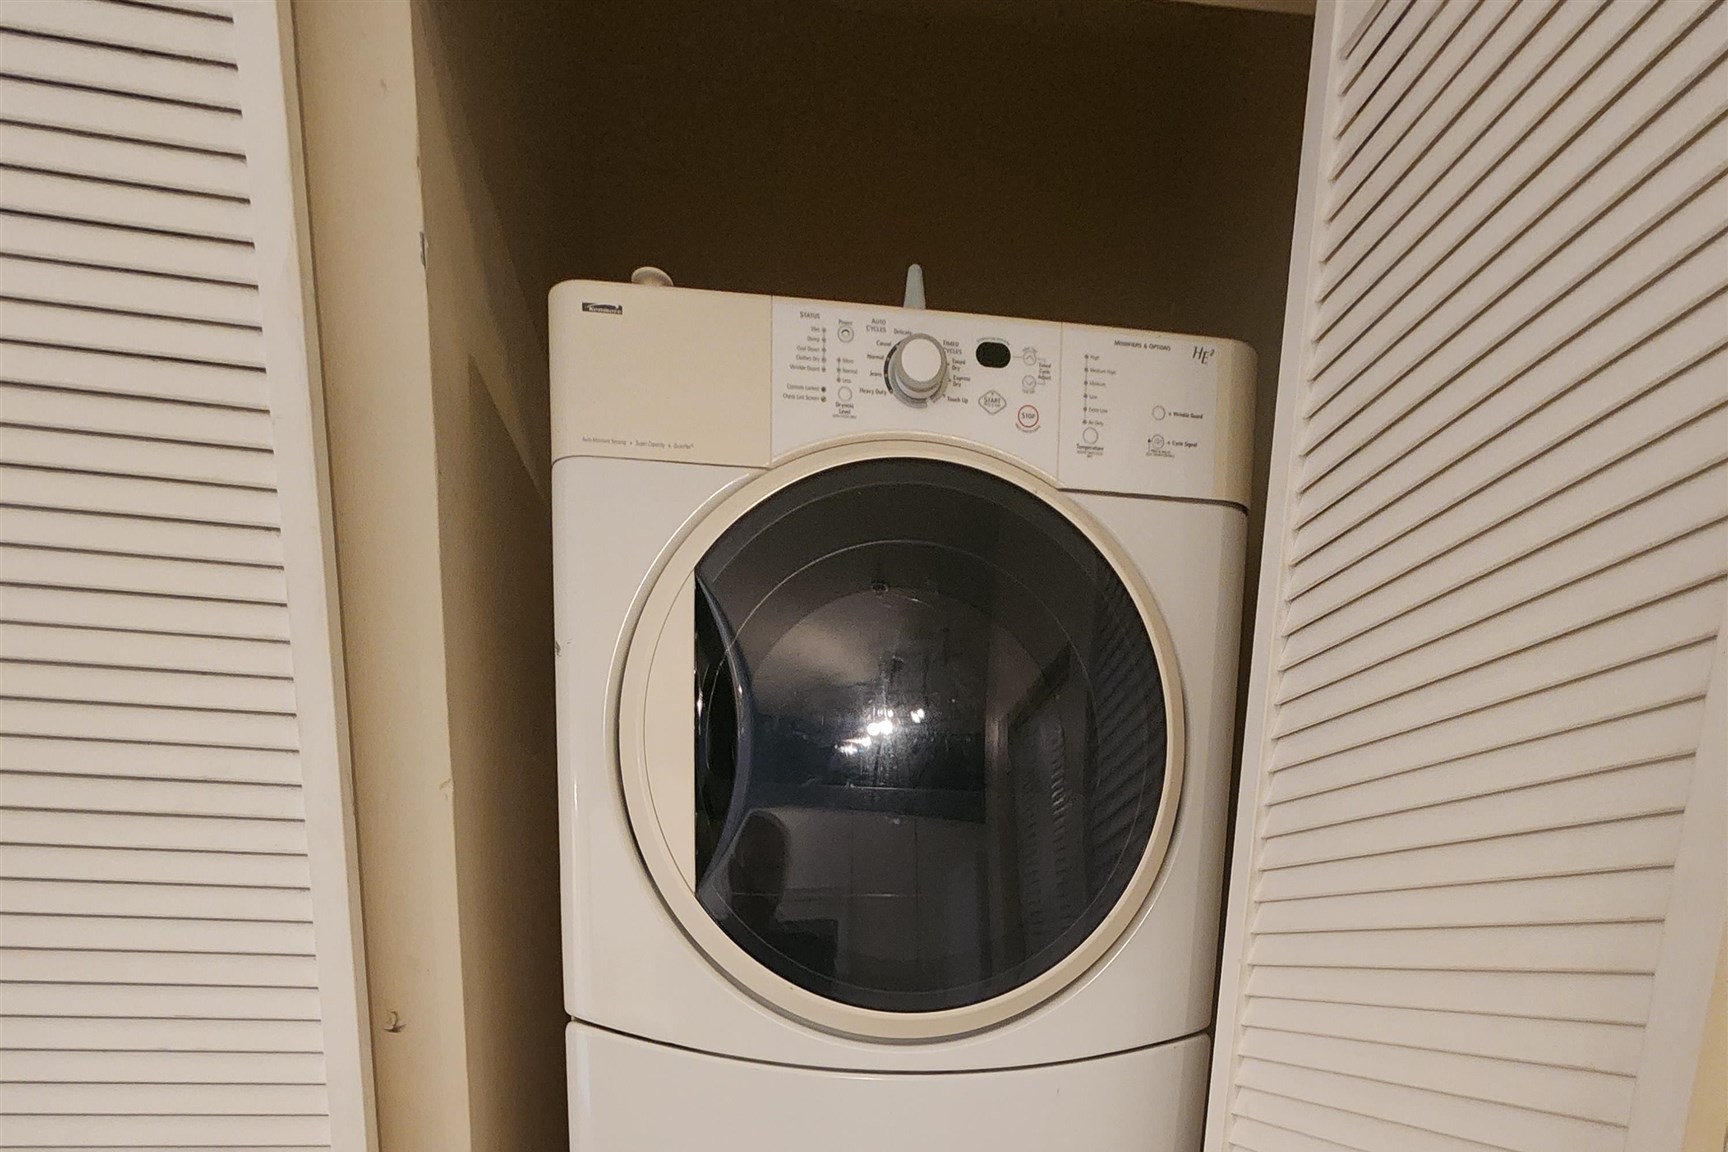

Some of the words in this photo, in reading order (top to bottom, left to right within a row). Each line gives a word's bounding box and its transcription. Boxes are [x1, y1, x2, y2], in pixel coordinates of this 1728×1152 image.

[800, 311, 820, 319] STATUS
[866, 325, 887, 333] CYCLES
[1149, 343, 1171, 351] OPTIONS
[983, 396, 1001, 404] START
[1021, 411, 1036, 420] STOP
